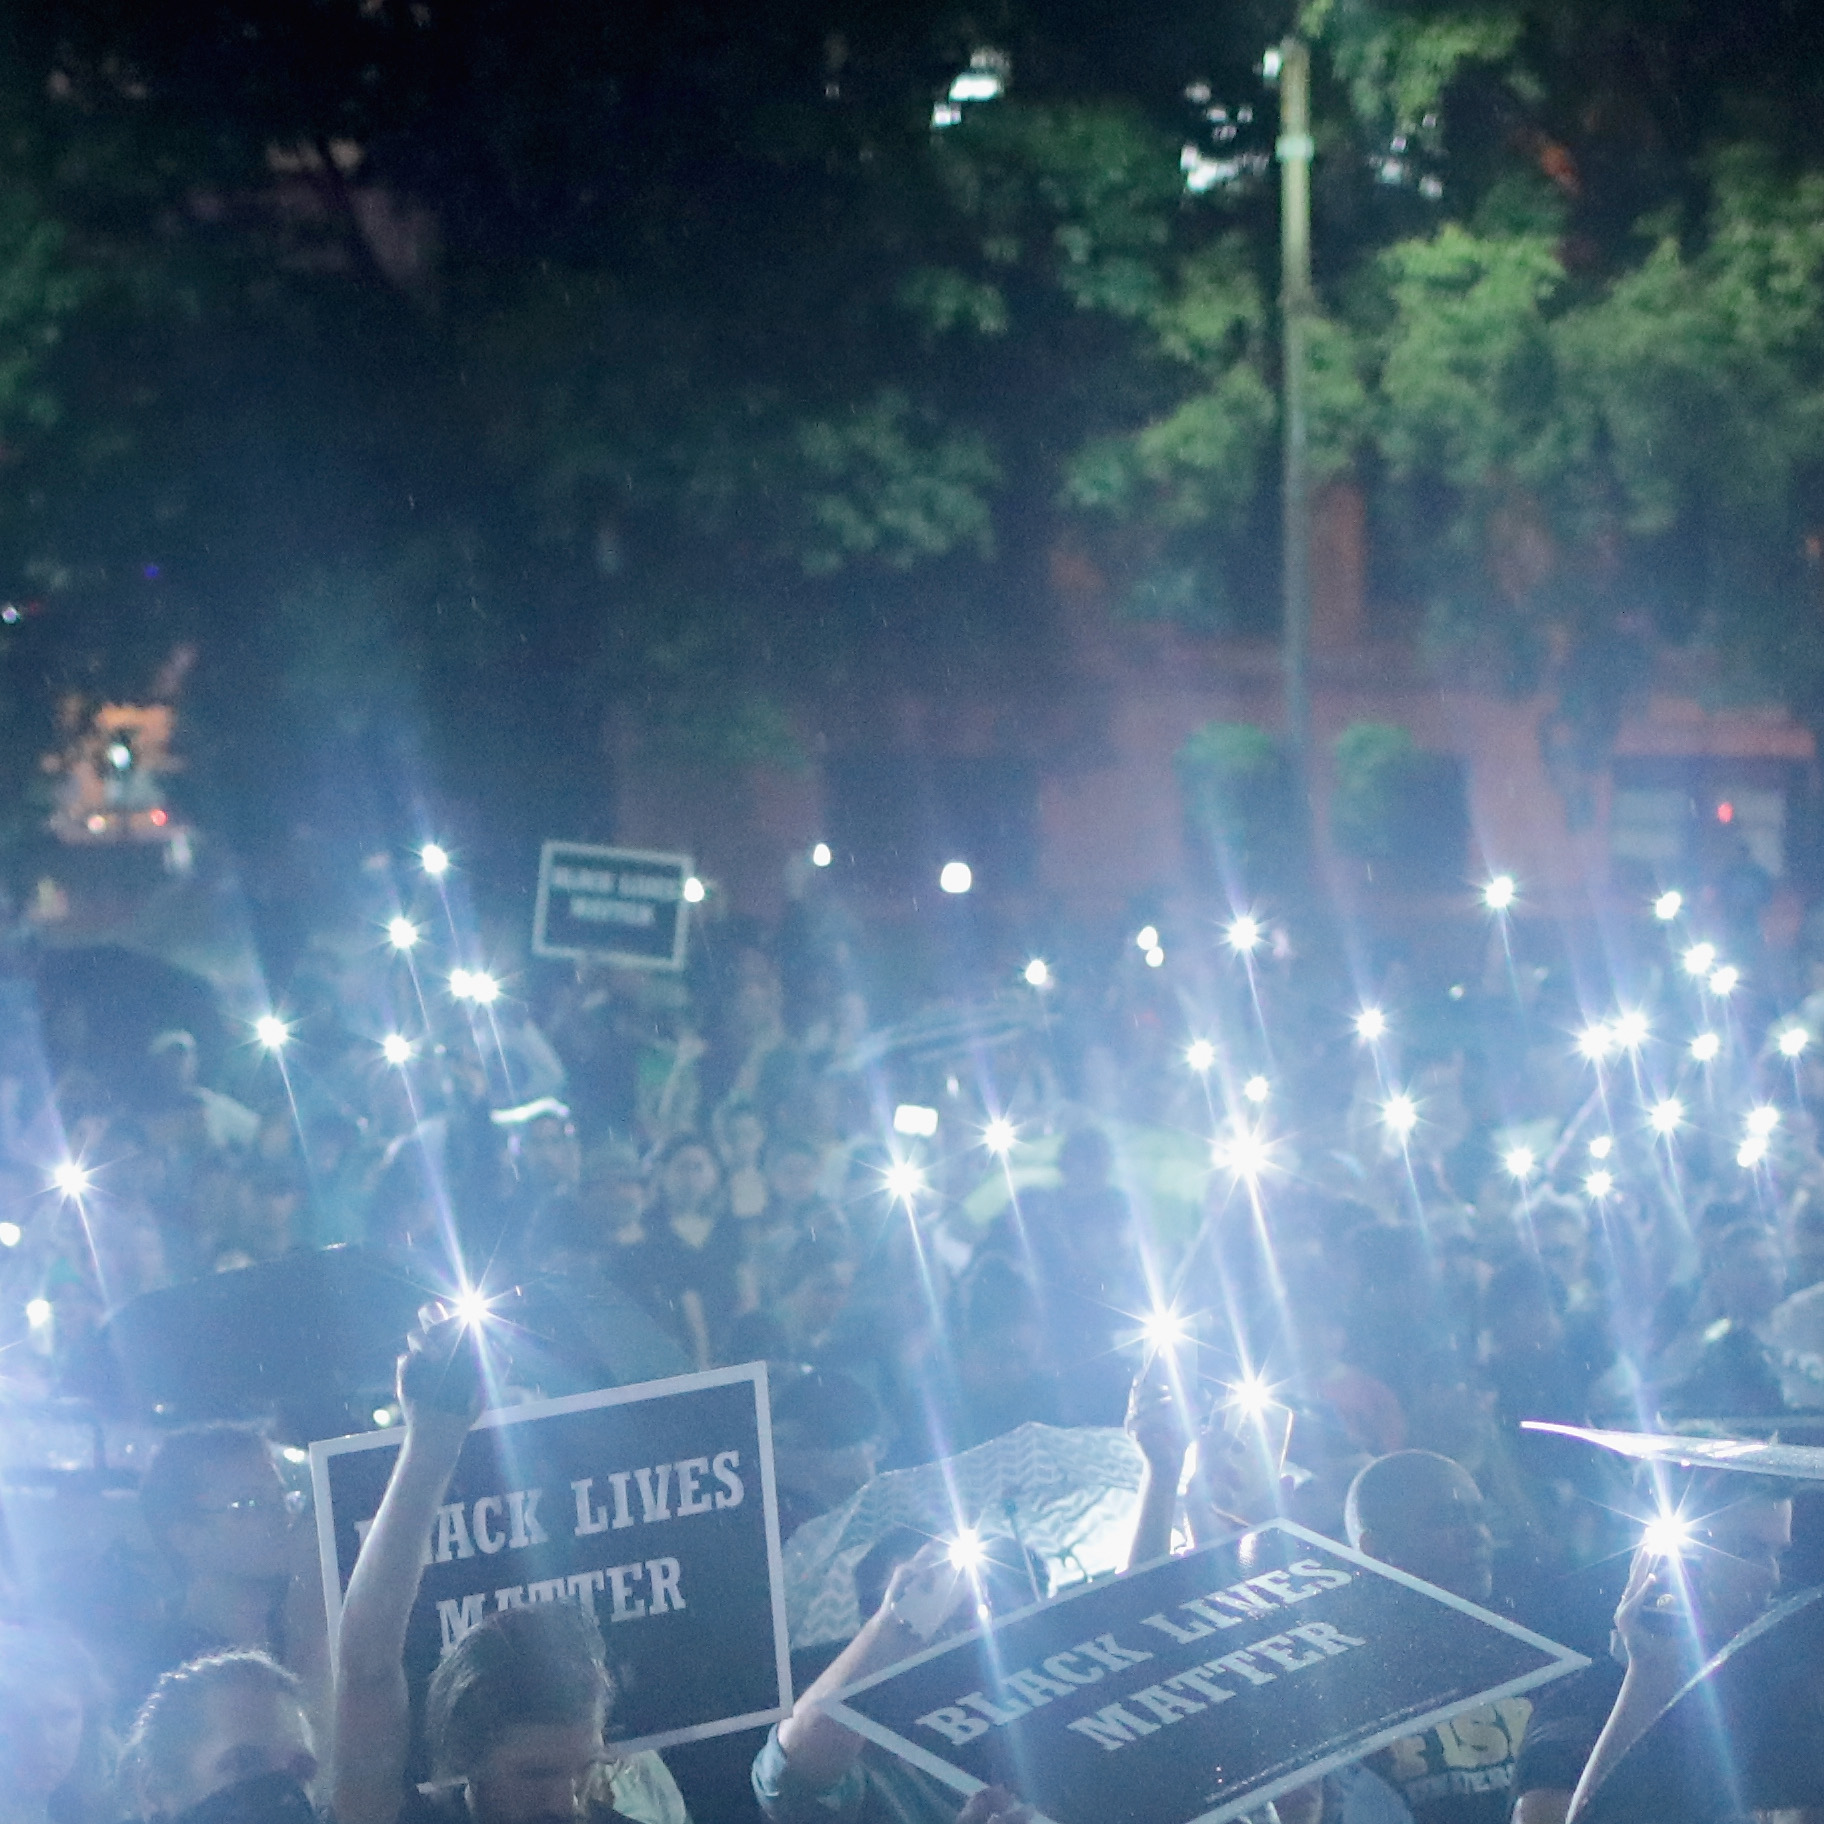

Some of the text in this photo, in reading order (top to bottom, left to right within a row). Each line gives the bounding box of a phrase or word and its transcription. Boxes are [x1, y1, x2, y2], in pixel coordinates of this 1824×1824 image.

[354, 1450, 745, 1565] ACK LIVES
[914, 1558, 1353, 1747] BLACK LIVES
[1067, 1620, 1367, 1751] MATTER
